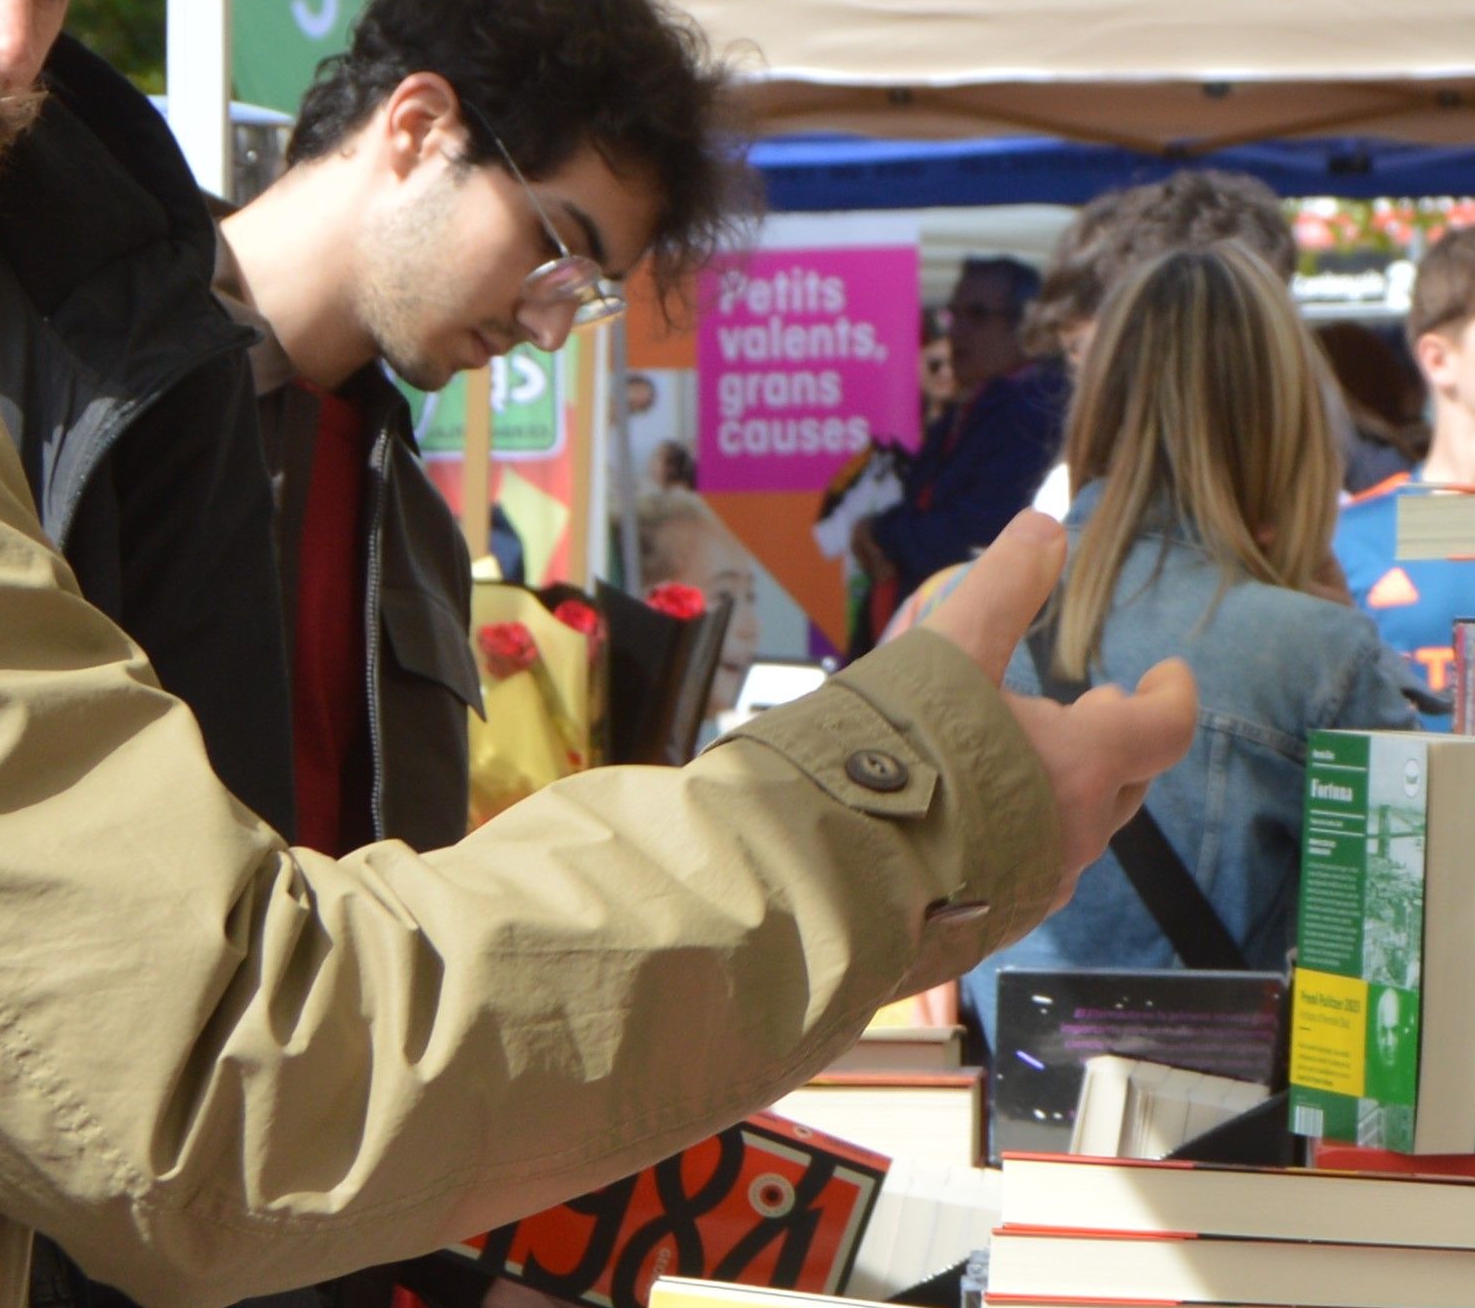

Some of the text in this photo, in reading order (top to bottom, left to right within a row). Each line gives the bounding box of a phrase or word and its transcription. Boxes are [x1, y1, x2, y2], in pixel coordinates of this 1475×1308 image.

[720, 267, 846, 315] Petits
[719, 315, 888, 365] valents,
[718, 370, 843, 419] grans
[719, 415, 869, 457] causes
[1310, 778, 1354, 802] Fortuna
